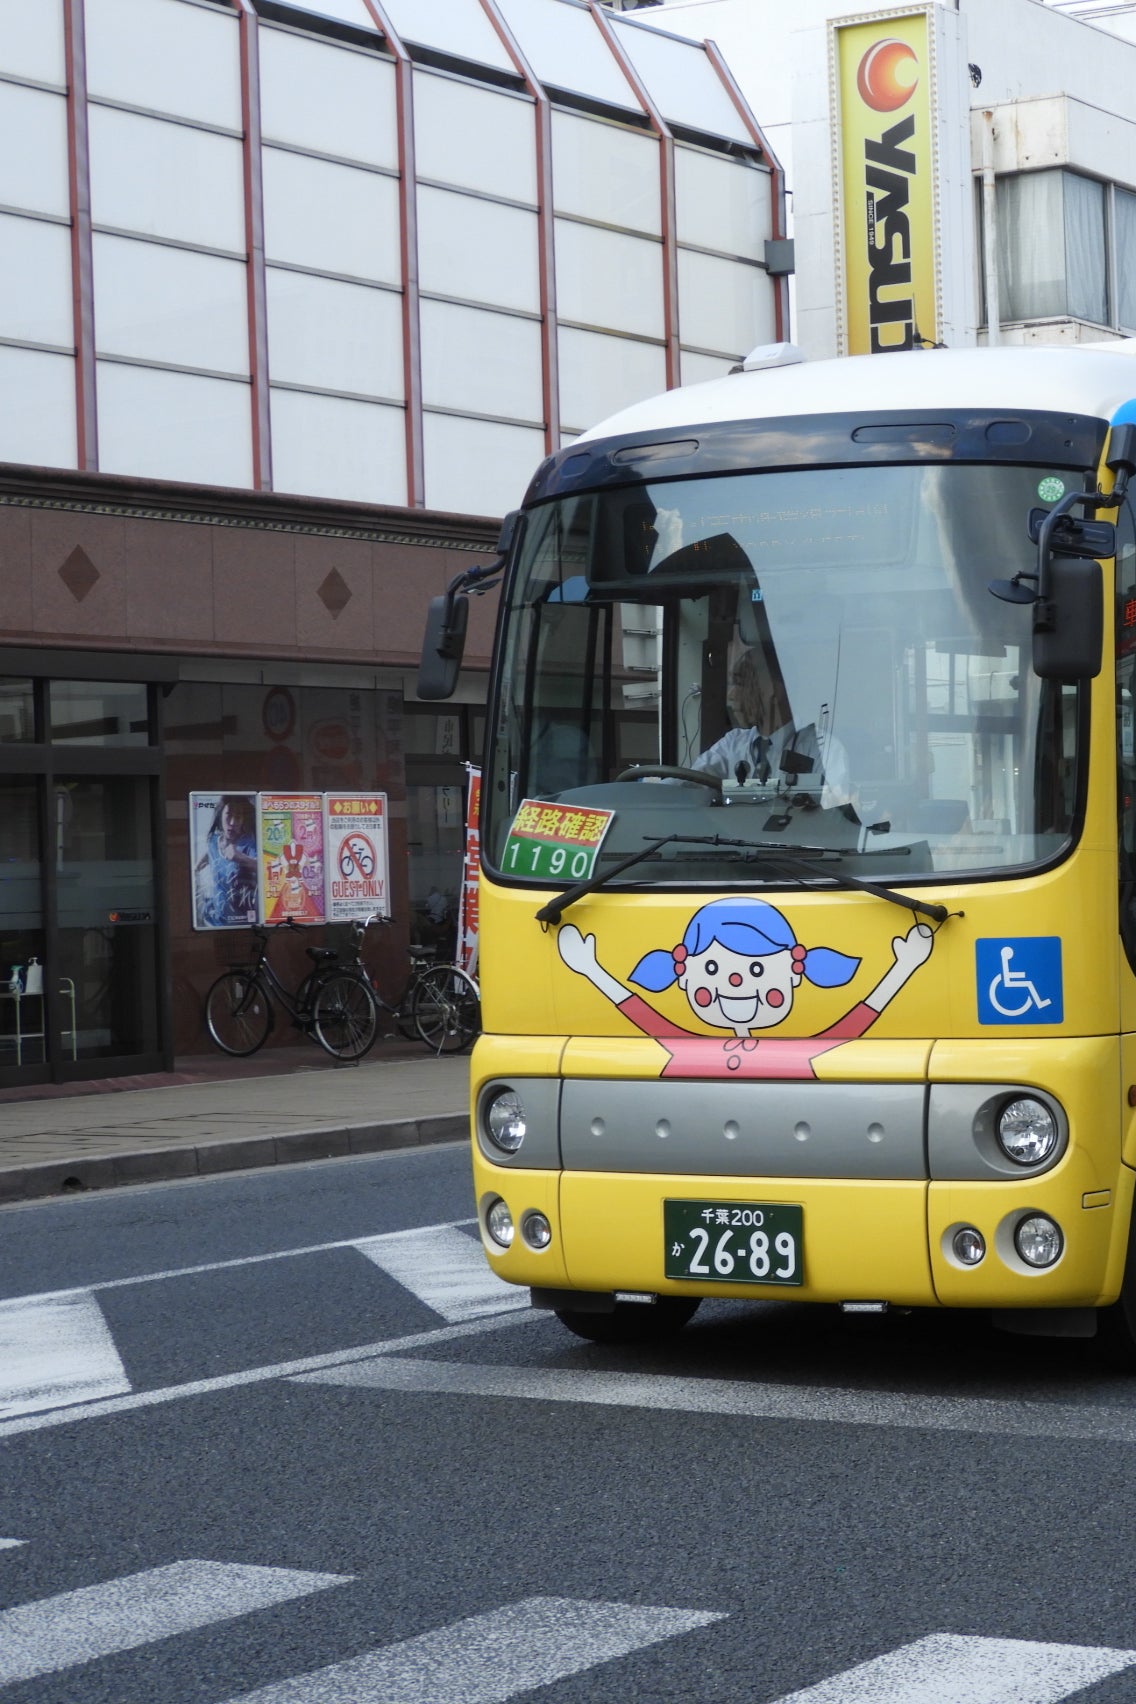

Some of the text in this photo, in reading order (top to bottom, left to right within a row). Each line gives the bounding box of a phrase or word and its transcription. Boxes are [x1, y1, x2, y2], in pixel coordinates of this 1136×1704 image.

[867, 199, 875, 223] SINCE
[513, 805, 609, 842] 経路確認
[510, 842, 588, 878] 1190
[701, 1208, 765, 1227] 千葉200
[671, 1227, 796, 1279] か 26-89
